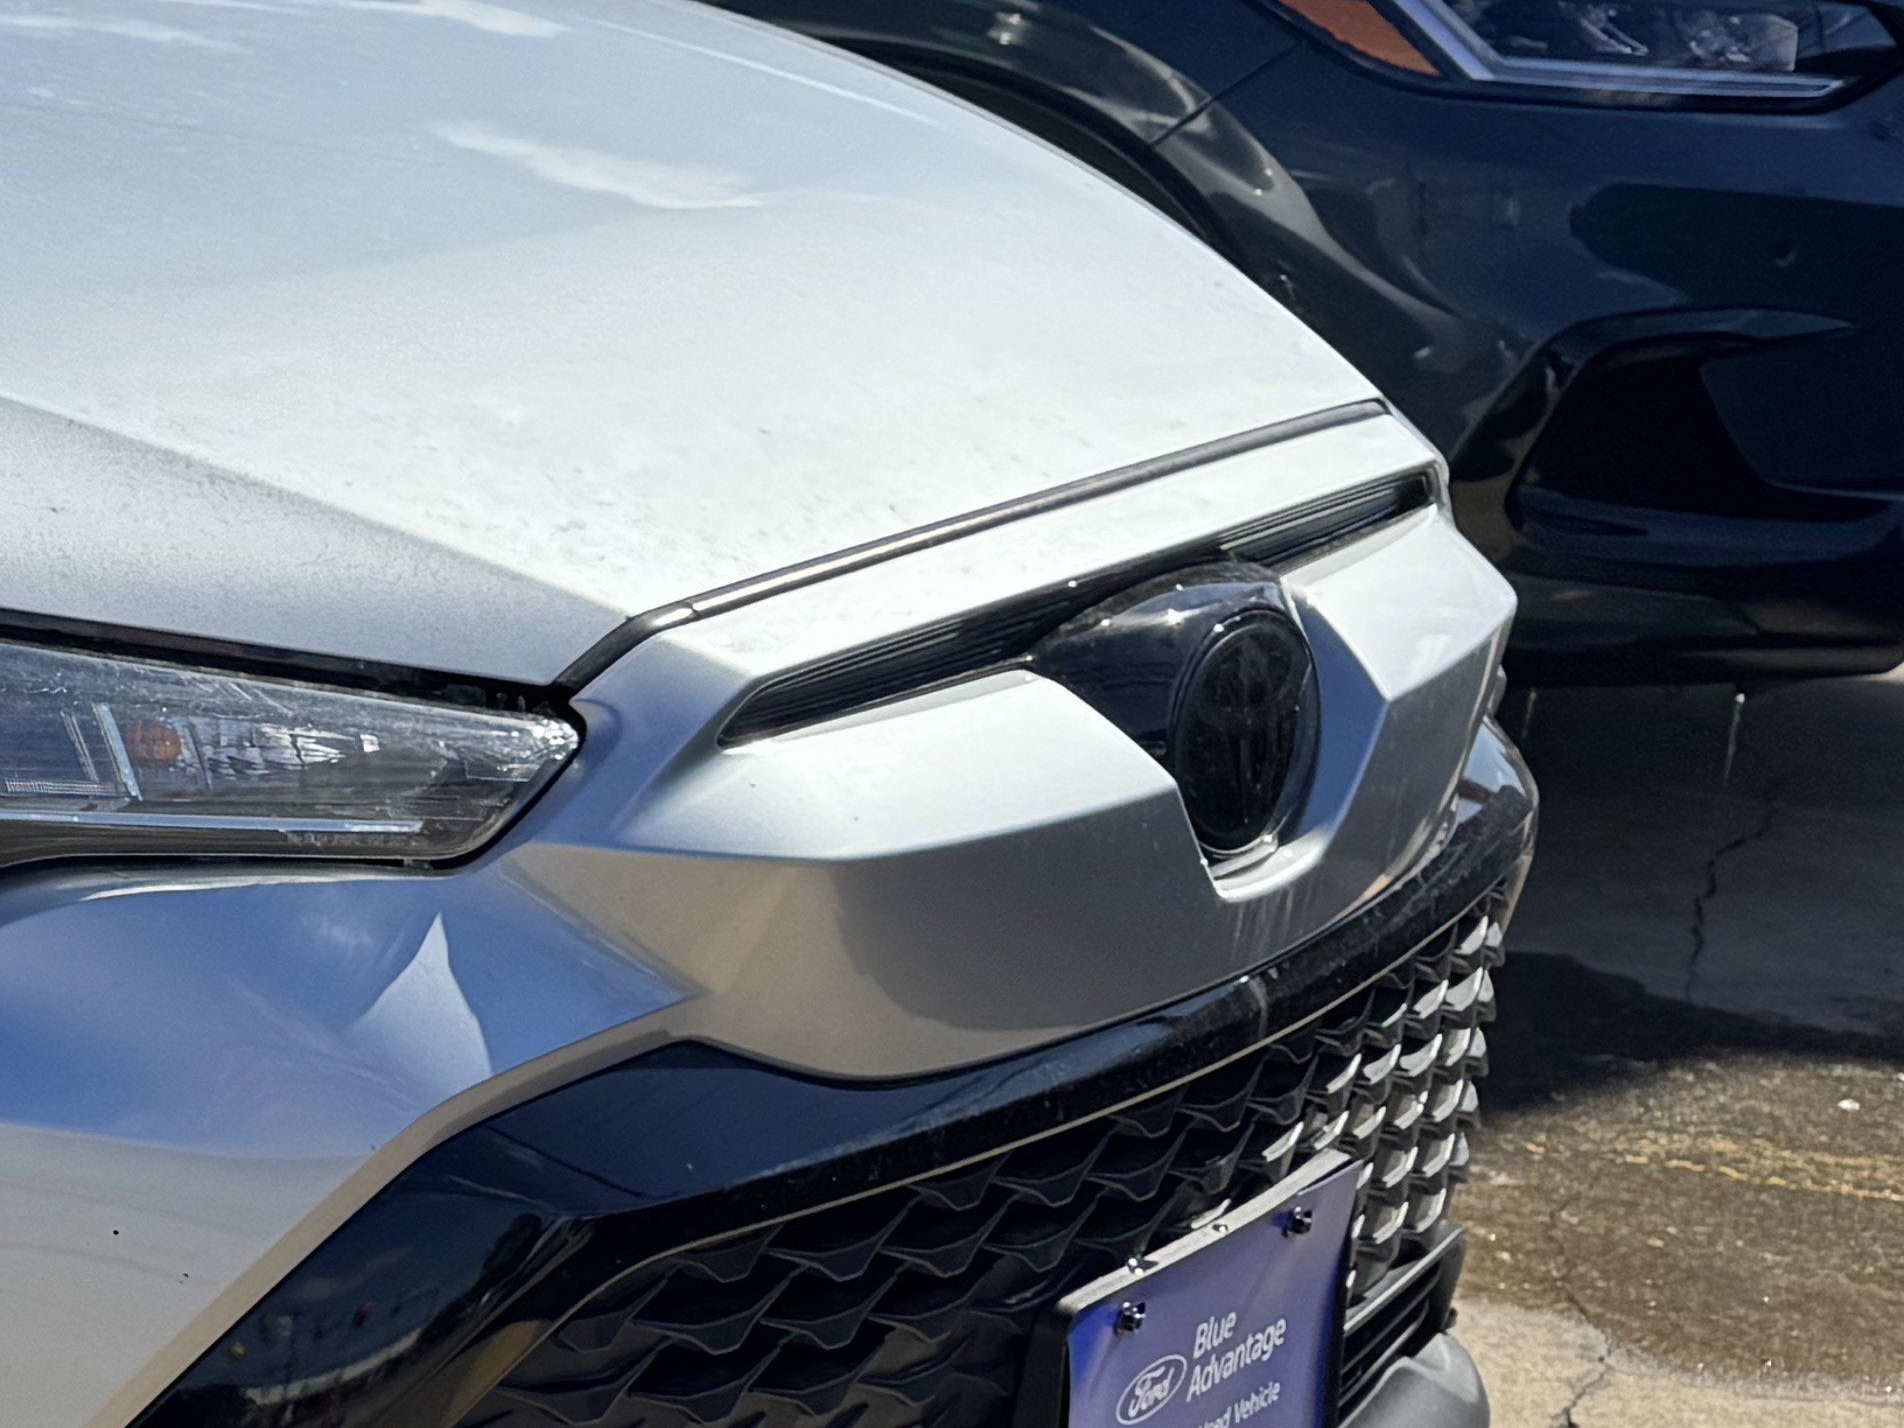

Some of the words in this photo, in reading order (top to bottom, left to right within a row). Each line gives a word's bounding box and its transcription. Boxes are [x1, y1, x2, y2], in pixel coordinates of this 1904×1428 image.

[1192, 1312, 1238, 1359] Blue
[1186, 1318, 1287, 1403] Advantage
[1234, 1380, 1282, 1425] Vehicle
